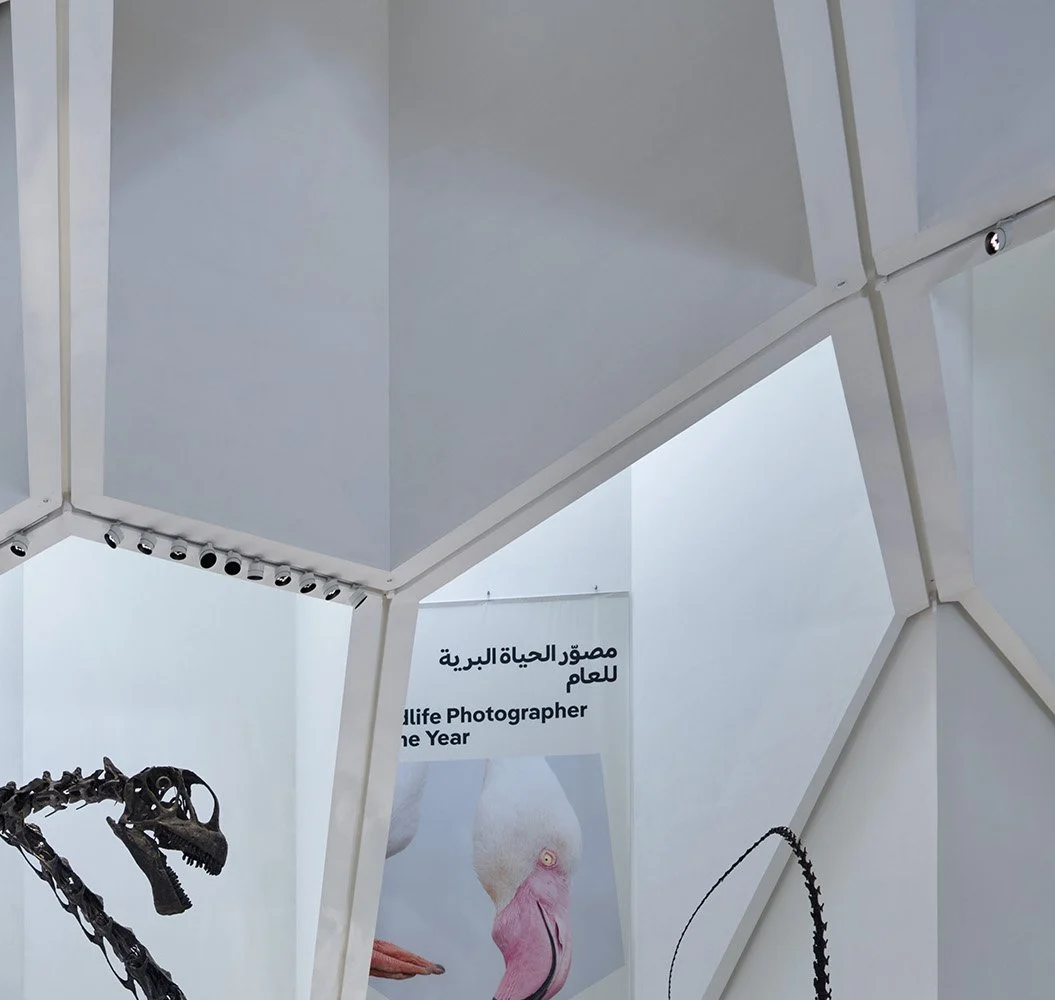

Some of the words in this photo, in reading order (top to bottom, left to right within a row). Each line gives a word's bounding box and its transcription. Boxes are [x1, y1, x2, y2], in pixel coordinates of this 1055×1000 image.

[439, 647, 496, 672] البرية
[500, 644, 556, 668] الحياة
[558, 644, 618, 666] مصوّر
[565, 665, 618, 693] للعام
[447, 702, 588, 725] Photographer
[425, 730, 470, 746] Year
